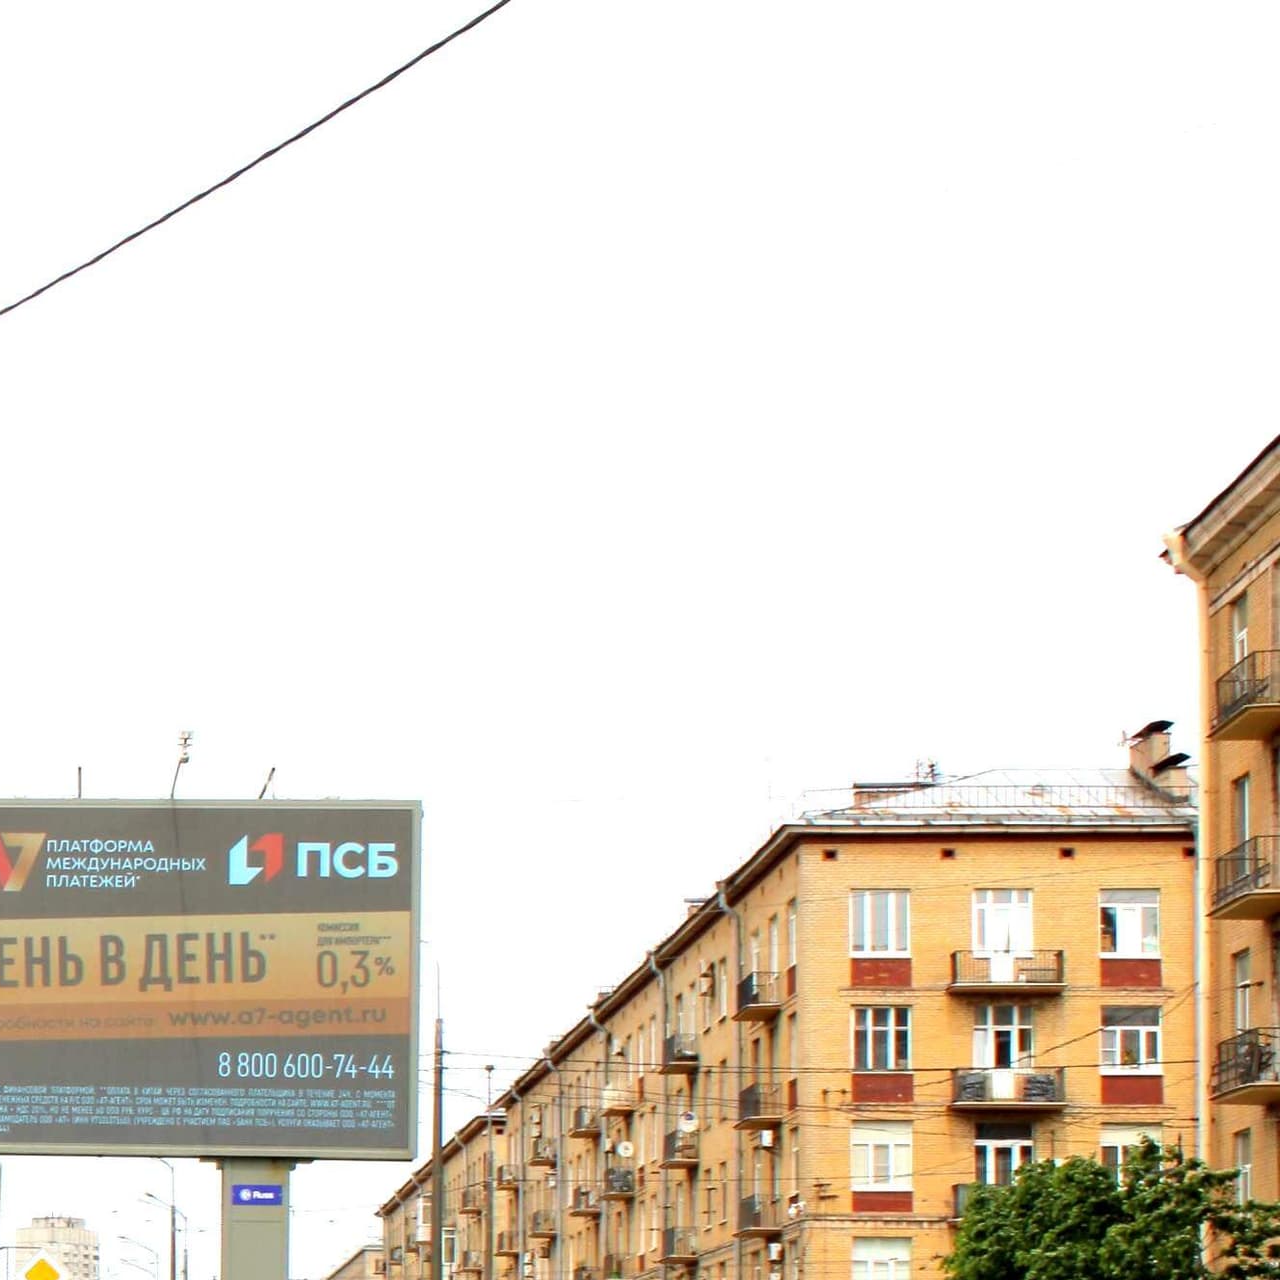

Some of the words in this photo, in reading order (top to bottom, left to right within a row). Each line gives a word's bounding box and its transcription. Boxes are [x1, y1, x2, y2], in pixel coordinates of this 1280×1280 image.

[46, 839, 155, 854] ПЛАТФОРМА
[46, 857, 207, 872] МЕЖДУНАРОДНЫХ
[296, 842, 399, 879] ПСБ
[99, 934, 127, 986] В
[168, 1007, 387, 1027] www.a7-agent.ru
[218, 1052, 231, 1077] 8
[237, 1052, 278, 1078] 800
[283, 1053, 395, 1079] 600-74-44
